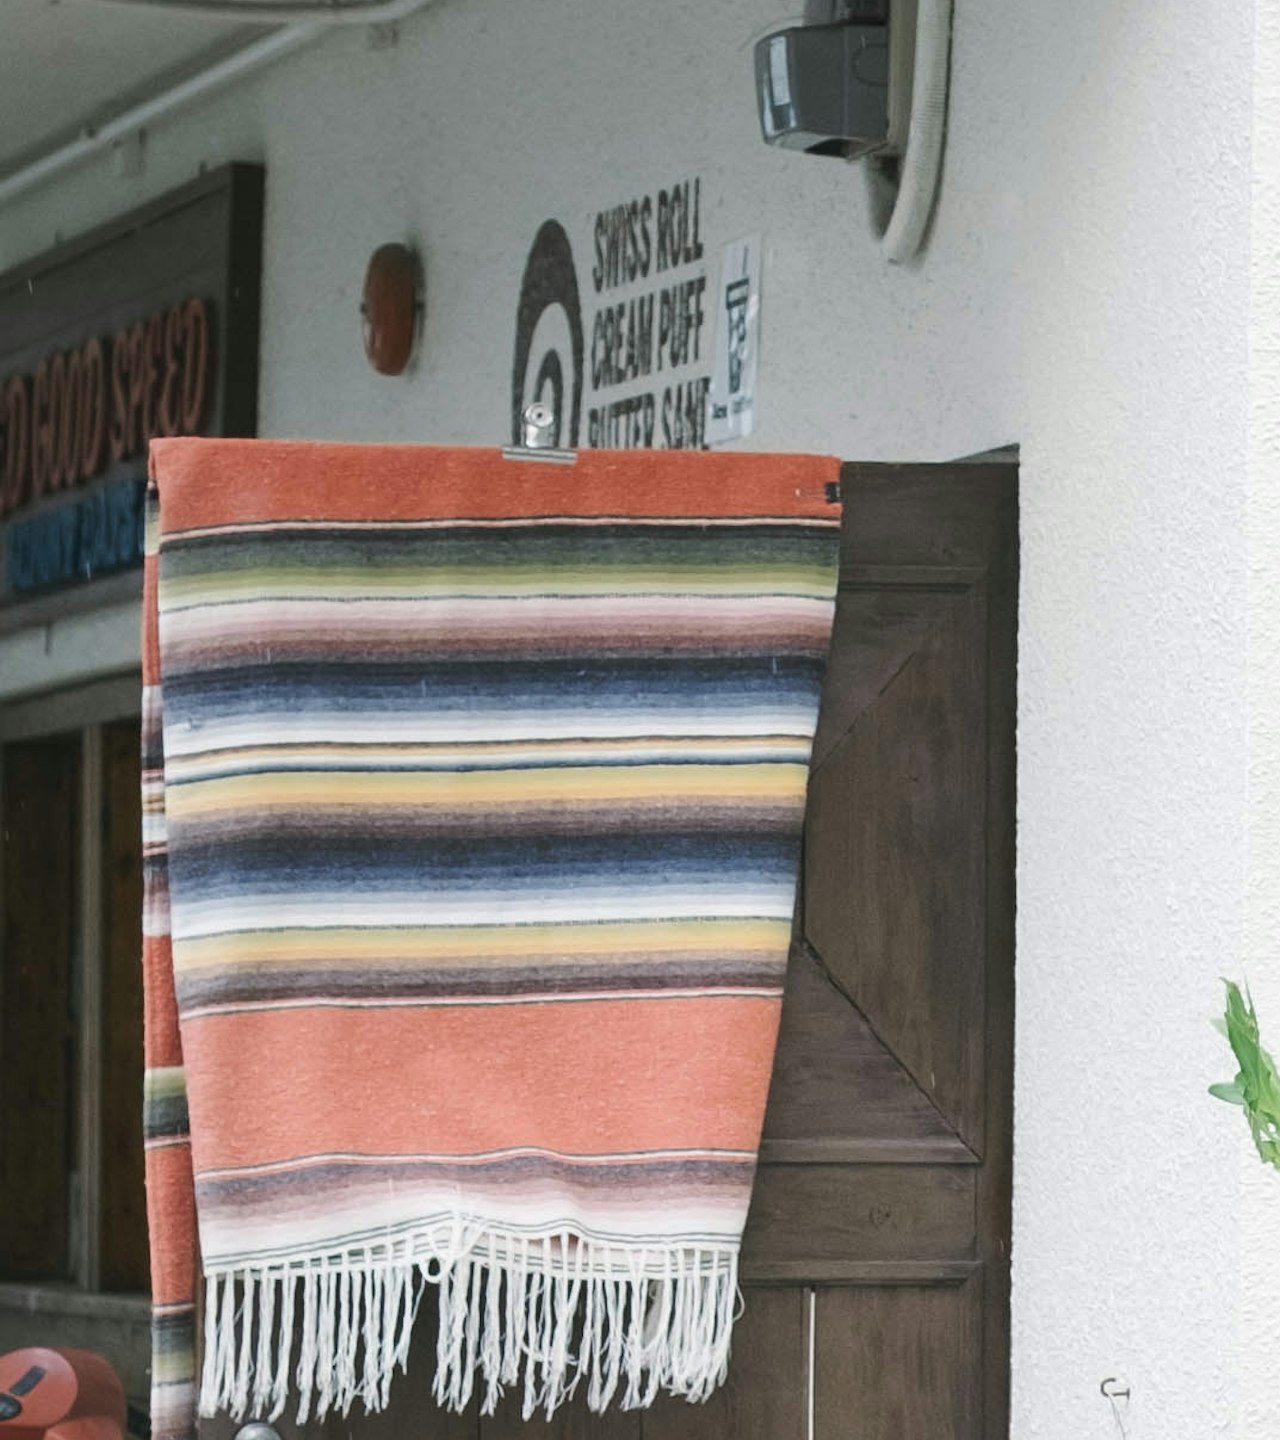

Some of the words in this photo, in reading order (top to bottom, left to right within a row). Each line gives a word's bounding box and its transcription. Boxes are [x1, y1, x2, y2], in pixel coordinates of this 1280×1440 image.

[593, 196, 652, 293] SWISS
[657, 176, 704, 273] ROLL
[592, 293, 654, 391] CREAM
[657, 275, 706, 371] PUFF
